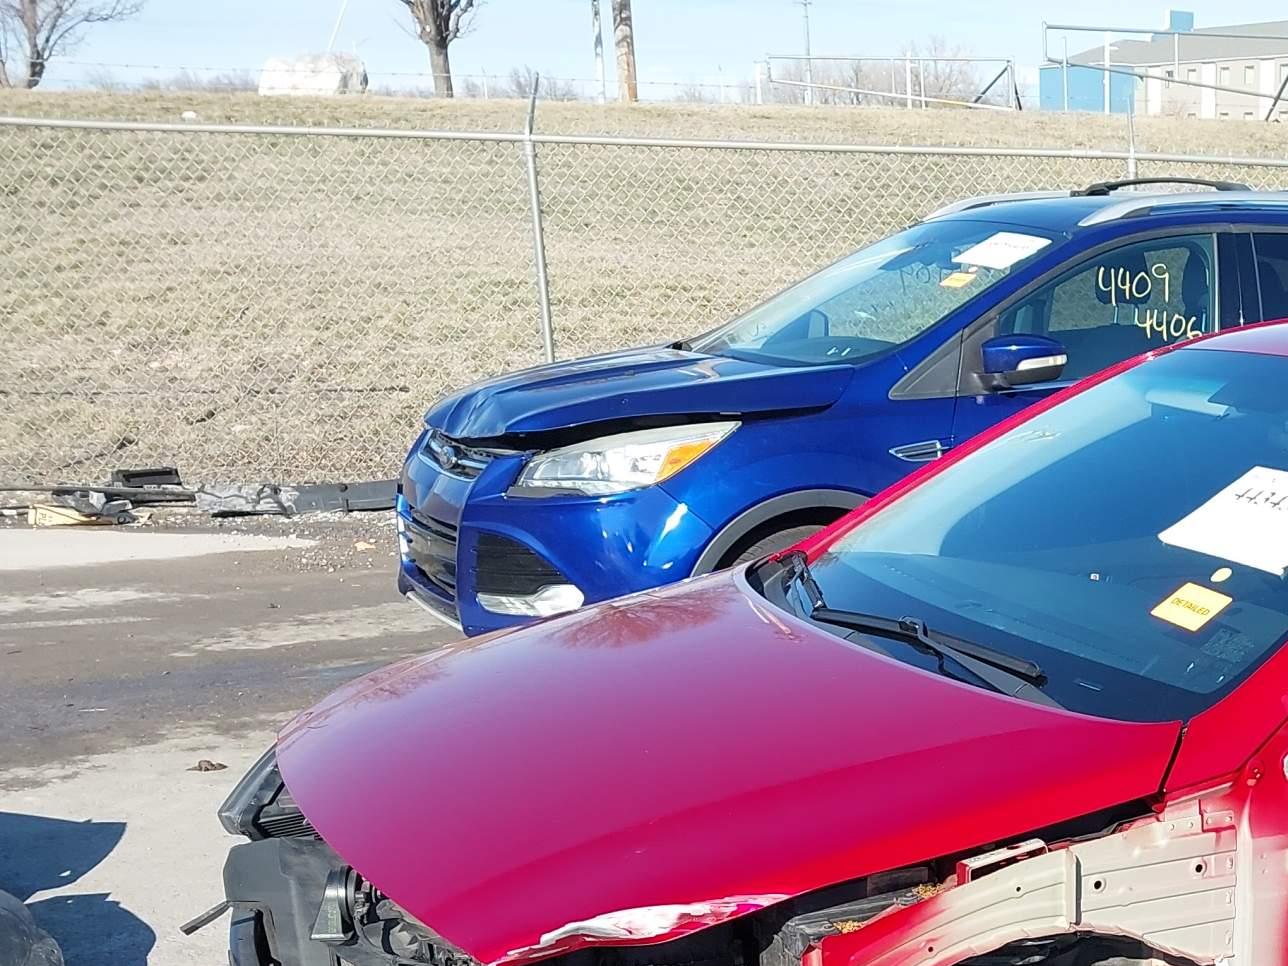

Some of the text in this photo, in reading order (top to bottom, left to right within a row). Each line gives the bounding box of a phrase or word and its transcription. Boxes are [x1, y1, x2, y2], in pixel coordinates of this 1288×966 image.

[1098, 263, 1169, 307] 4409
[1134, 308, 1203, 342] 4406
[1170, 596, 1211, 617] DETAILED
